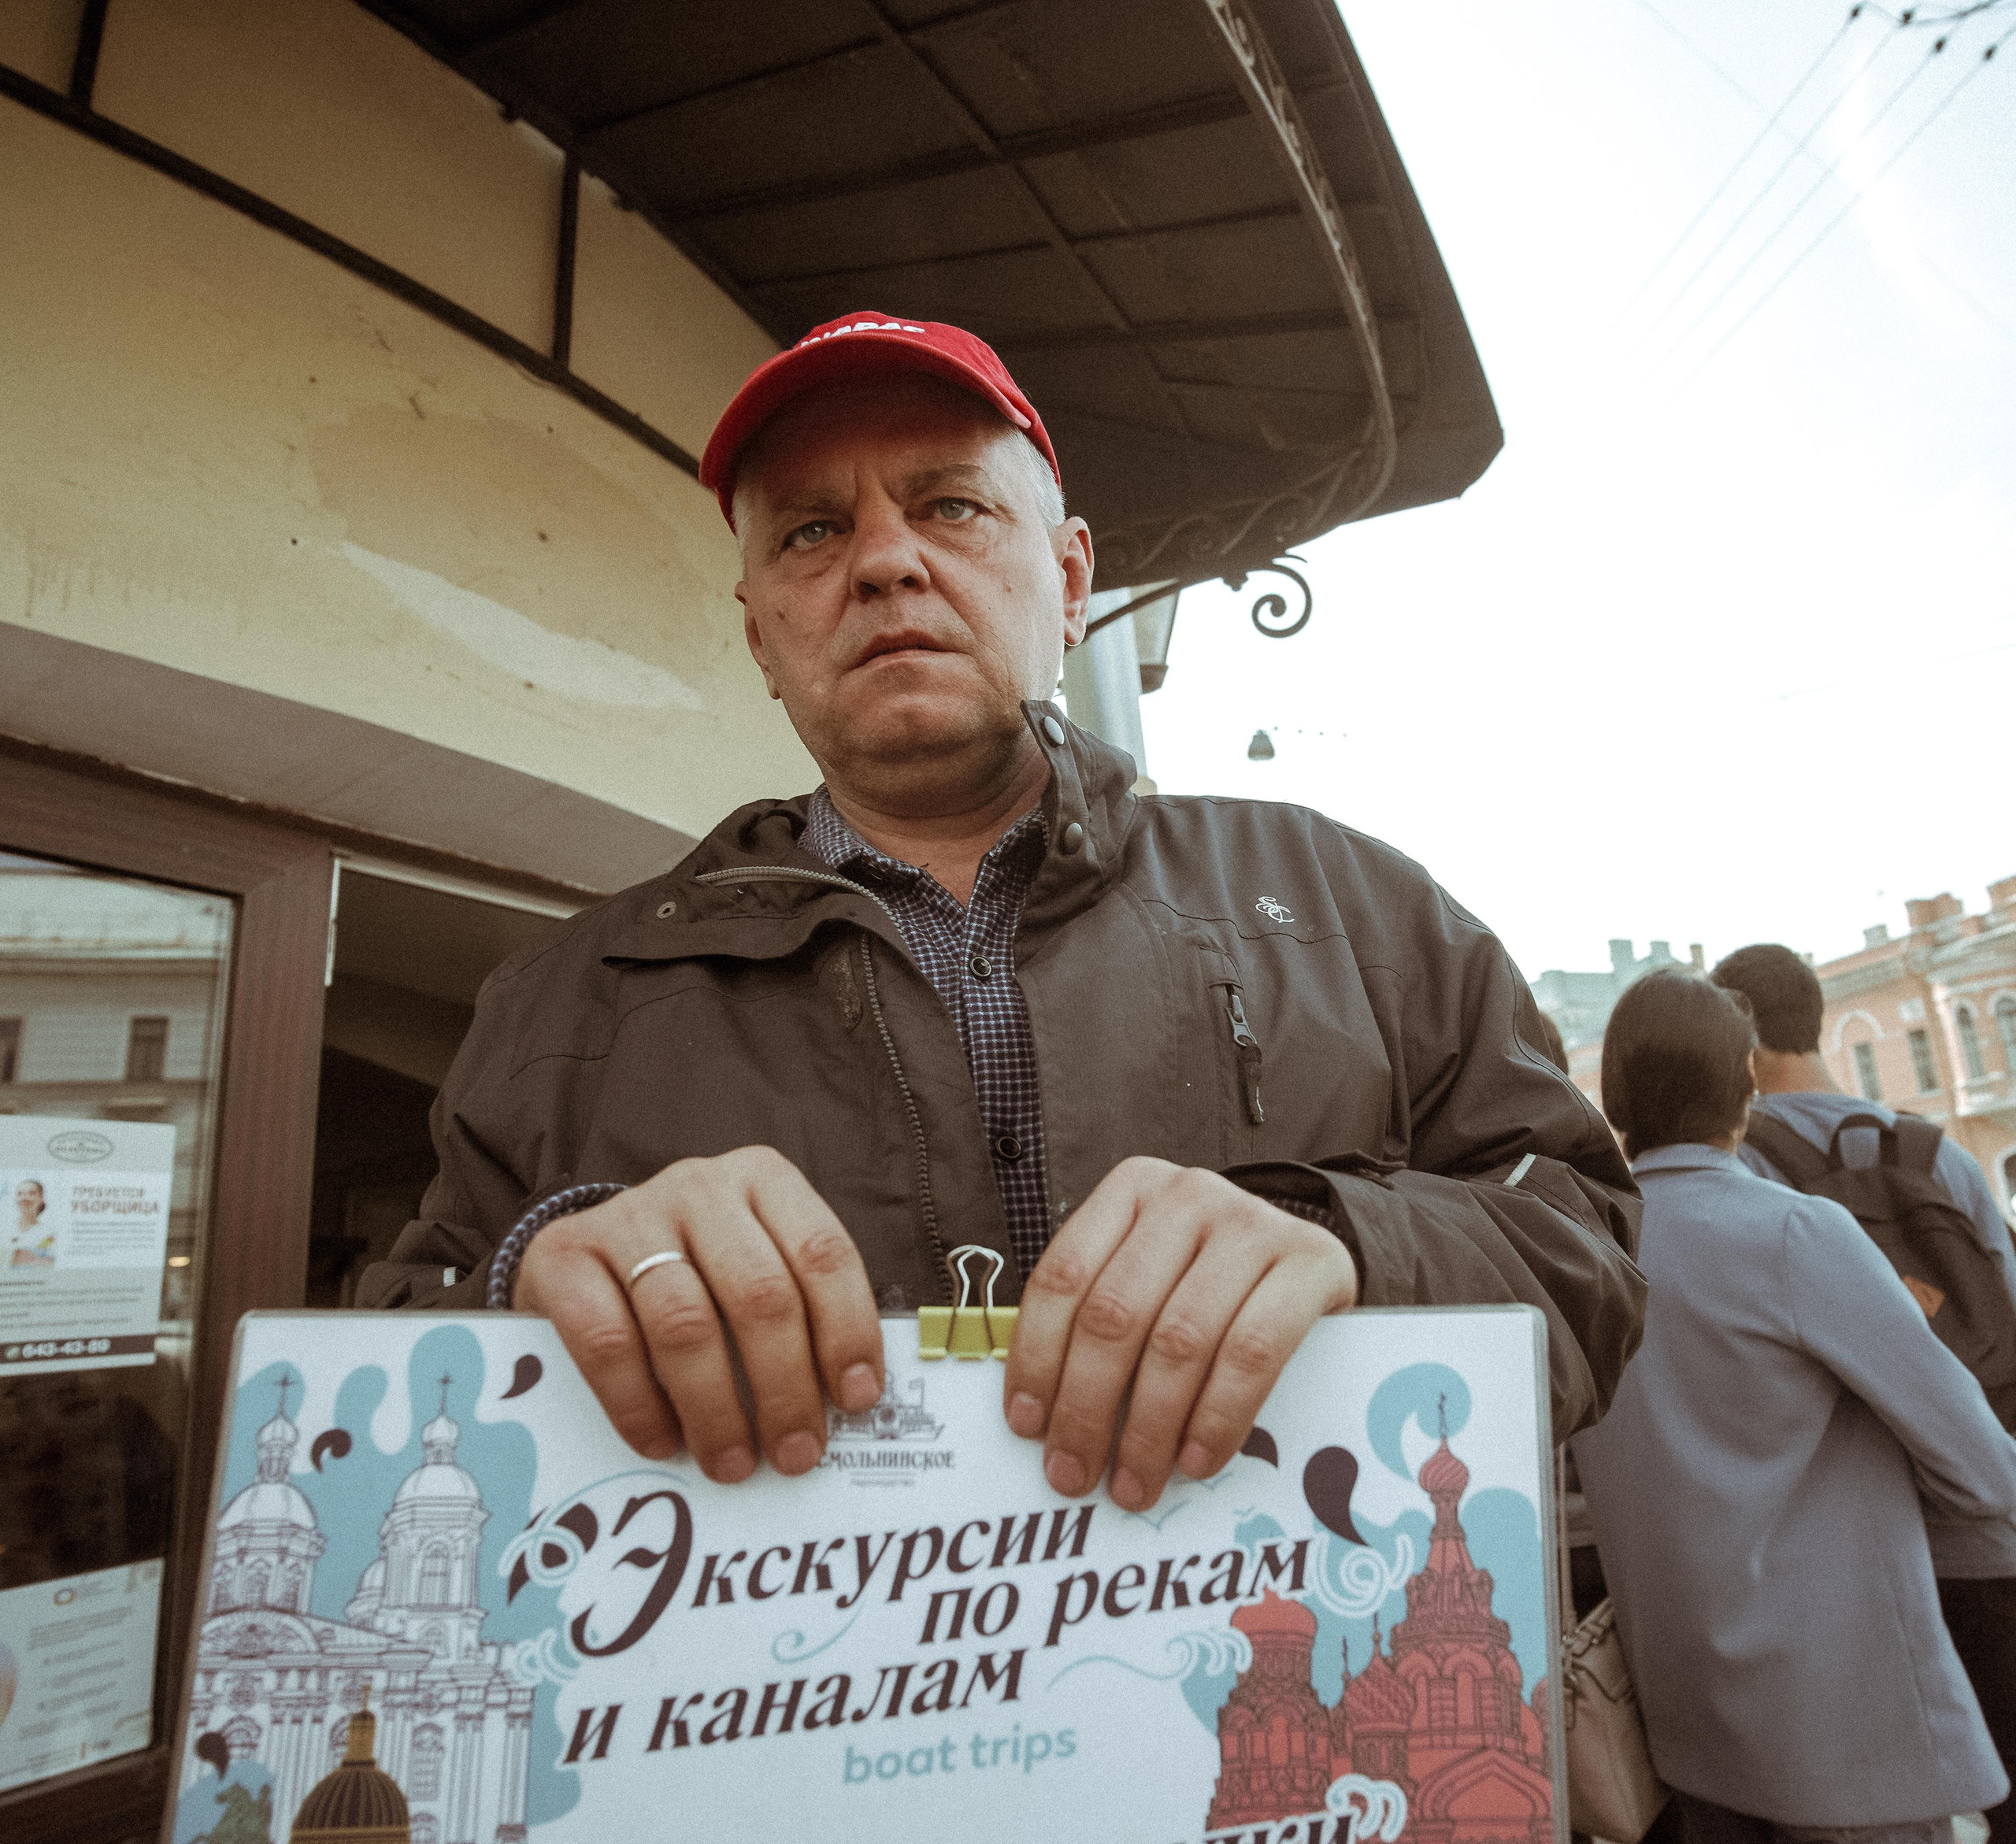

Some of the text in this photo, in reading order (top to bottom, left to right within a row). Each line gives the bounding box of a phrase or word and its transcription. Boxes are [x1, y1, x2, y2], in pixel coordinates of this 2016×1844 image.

[70, 1200, 159, 1214] УБОРЩИЦА
[570, 1489, 1098, 1658] Экскурсии
[917, 1539, 1310, 1648] по рекам
[562, 1648, 1027, 1764] и каналам
[843, 1722, 1077, 1784] boat trips
